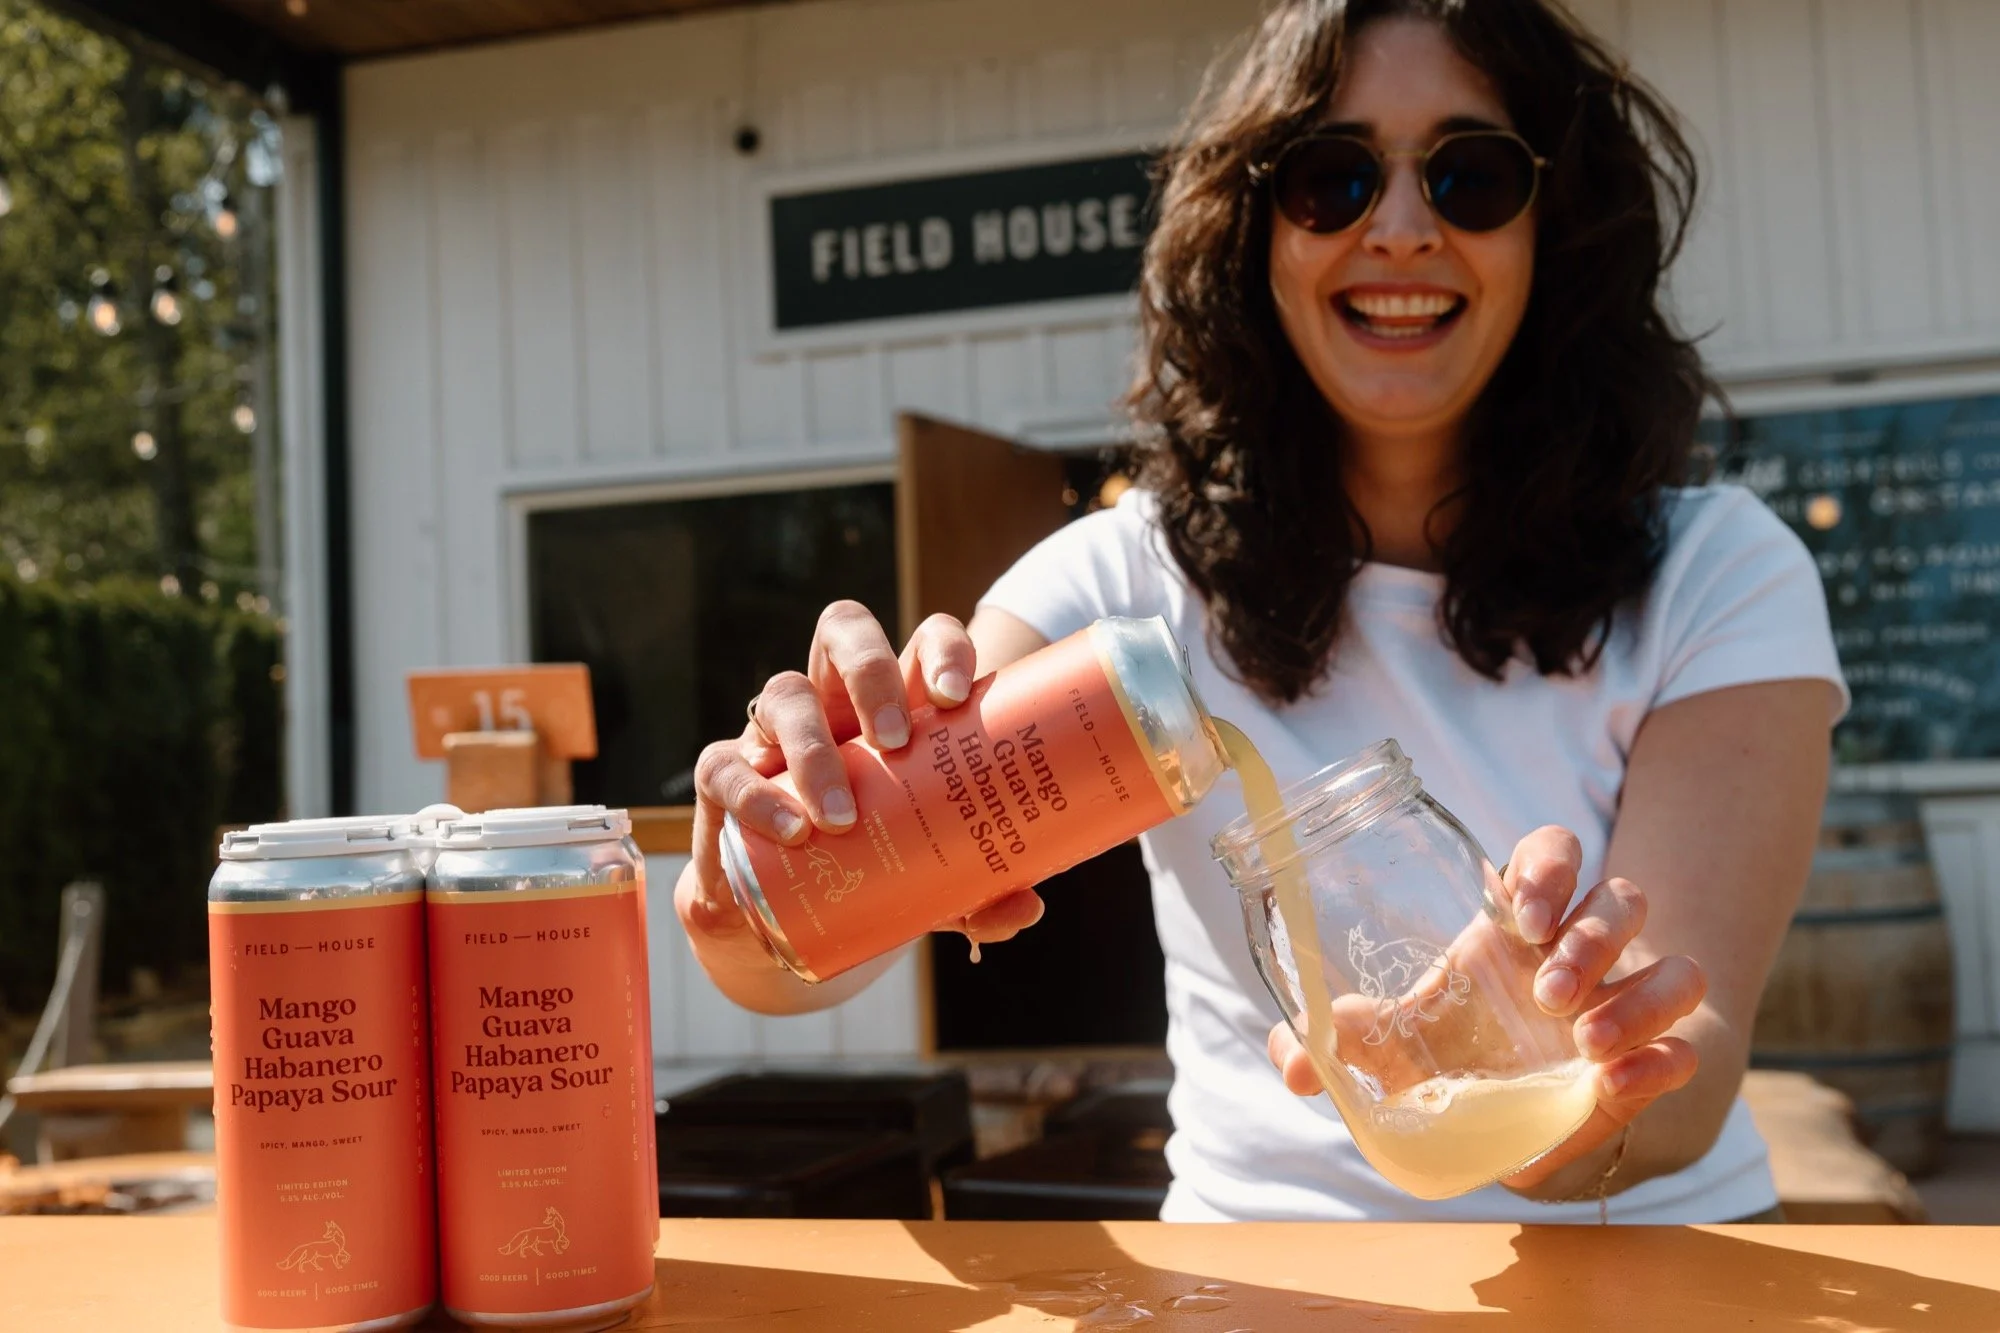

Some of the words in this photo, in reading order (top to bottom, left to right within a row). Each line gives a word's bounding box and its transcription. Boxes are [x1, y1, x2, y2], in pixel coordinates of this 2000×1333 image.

[811, 215, 952, 283] FIELD
[971, 194, 1139, 265] HOUSE
[474, 688, 534, 732] 15
[1068, 688, 1095, 732] FIELD
[1099, 754, 1130, 803] HOUSE
[1016, 722, 1068, 812] Mango
[957, 730, 1026, 855] Habanero
[993, 739, 1041, 823] Guava
[928, 726, 977, 821] Papaya
[969, 820, 1010, 874] Sour
[871, 809, 890, 842] LIMITED
[886, 841, 906, 873] EDITION
[780, 853, 796, 880] BEERS
[931, 842, 949, 868] SWEET
[798, 893, 814, 915] GOOD
[810, 913, 827, 936] TIMES
[244, 943, 289, 956] FIELD
[318, 937, 376, 952] HOUSE
[464, 932, 509, 945] FIELD
[536, 926, 591, 940] HOUSE
[258, 996, 357, 1023] Mango
[478, 985, 574, 1013] Mango
[625, 974, 634, 1037] SOUR
[262, 1027, 354, 1050] Guava
[481, 1015, 572, 1038] Guava
[244, 1054, 383, 1080] Habanero
[464, 1039, 600, 1068] Habanero
[230, 1081, 324, 1113] Papaya
[331, 1077, 398, 1104] Sour
[451, 1069, 544, 1100] Papaya
[550, 1063, 613, 1091] Sour
[629, 1066, 640, 1162] SERIES
[260, 1141, 288, 1151] SPICY,
[291, 1139, 329, 1149] MANGO,
[332, 1135, 363, 1146] SWEET
[481, 1127, 510, 1137] SPICY,
[551, 1123, 581, 1133] SWEET
[497, 1167, 531, 1177] LIMITED
[532, 1165, 568, 1175] EDITION
[276, 1182, 310, 1192] LIMITED
[312, 1178, 348, 1189] EDITION
[479, 1273, 499, 1282] GOOD
[500, 1273, 529, 1282] BEERS
[545, 1269, 571, 1280] GOOD
[572, 1266, 598, 1278] TIMES
[257, 1289, 278, 1298] GOOD
[279, 1289, 307, 1298] BEERS
[325, 1284, 351, 1295] GOOD
[352, 1280, 379, 1292] TIMES
